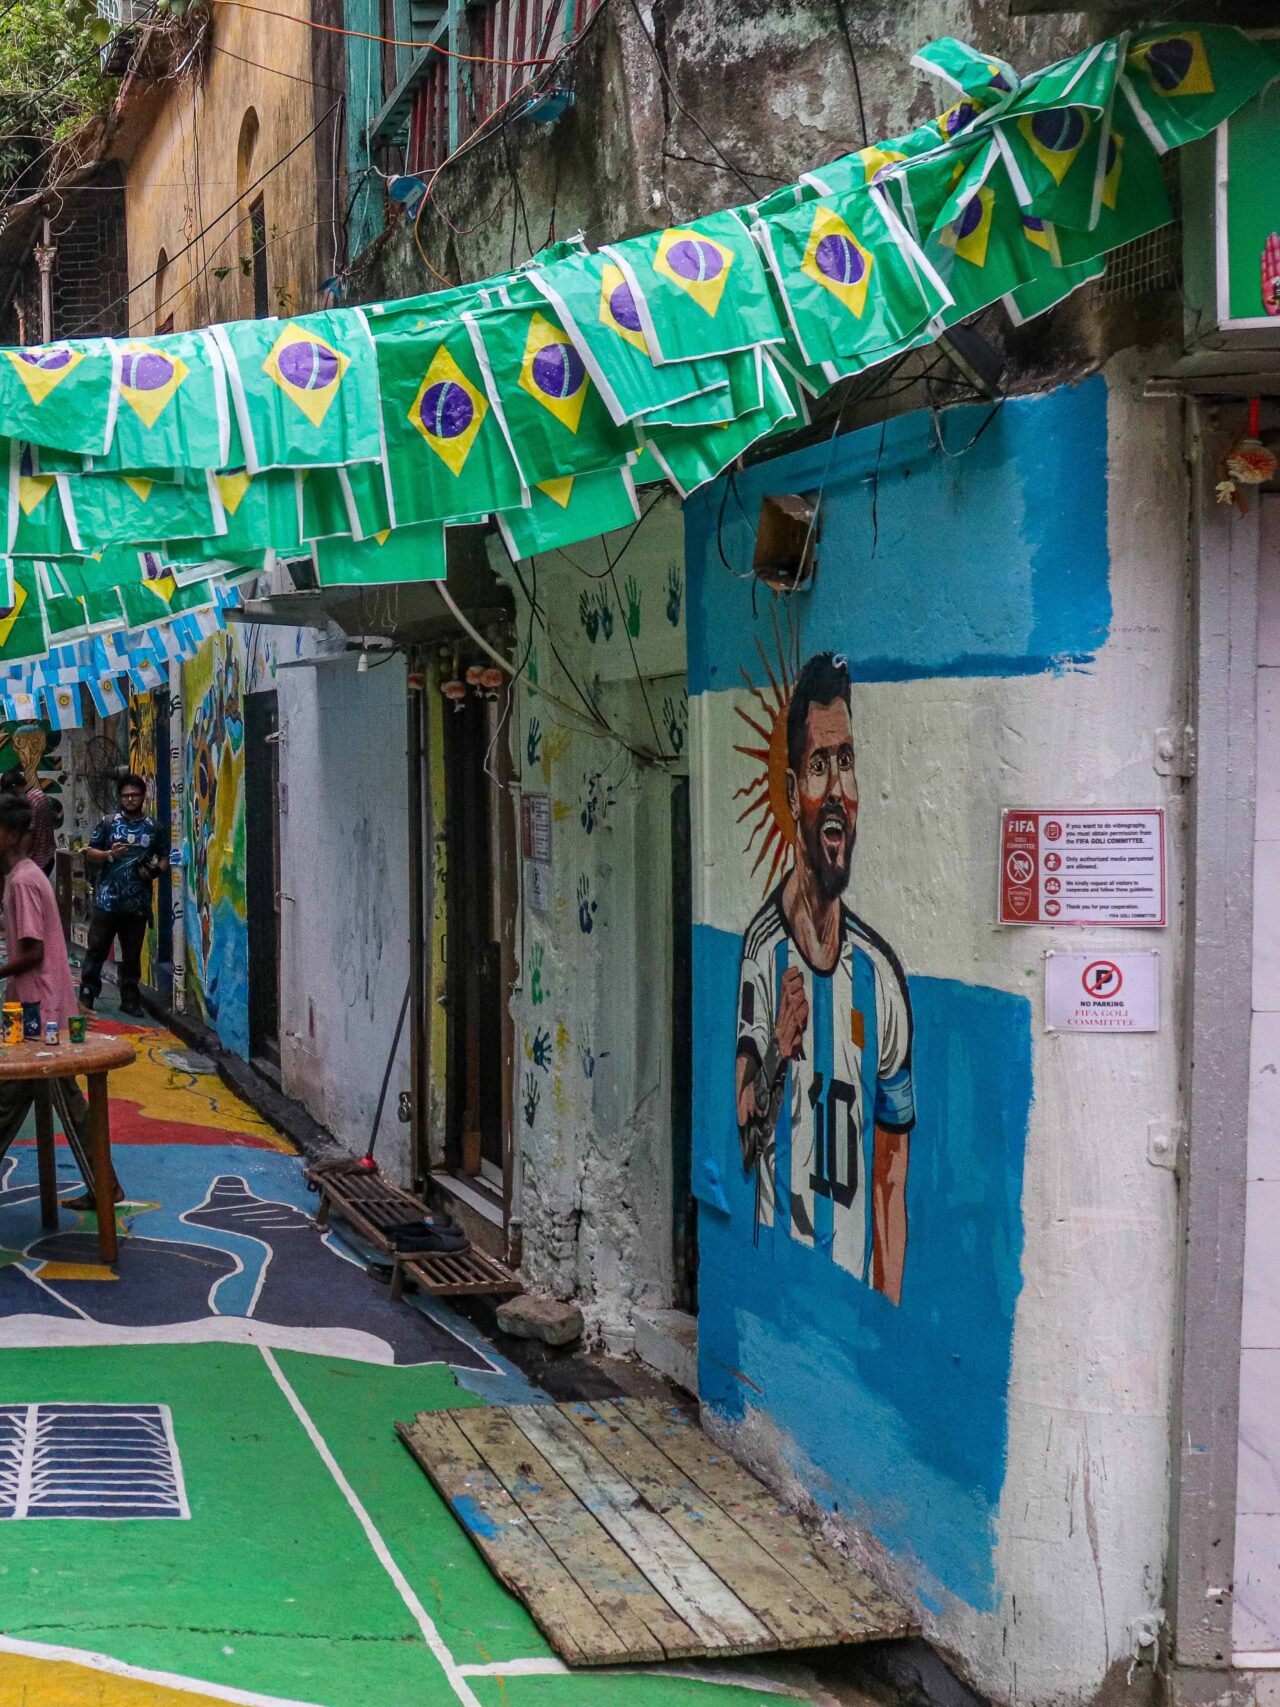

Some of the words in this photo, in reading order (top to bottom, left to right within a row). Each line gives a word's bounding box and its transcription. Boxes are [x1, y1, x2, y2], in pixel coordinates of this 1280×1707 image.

[1008, 821, 1036, 832] FIFA
[1127, 855, 1154, 863] personnel
[1067, 1018, 1137, 1026] COMMITTEE
[808, 1071, 858, 1210] 10
